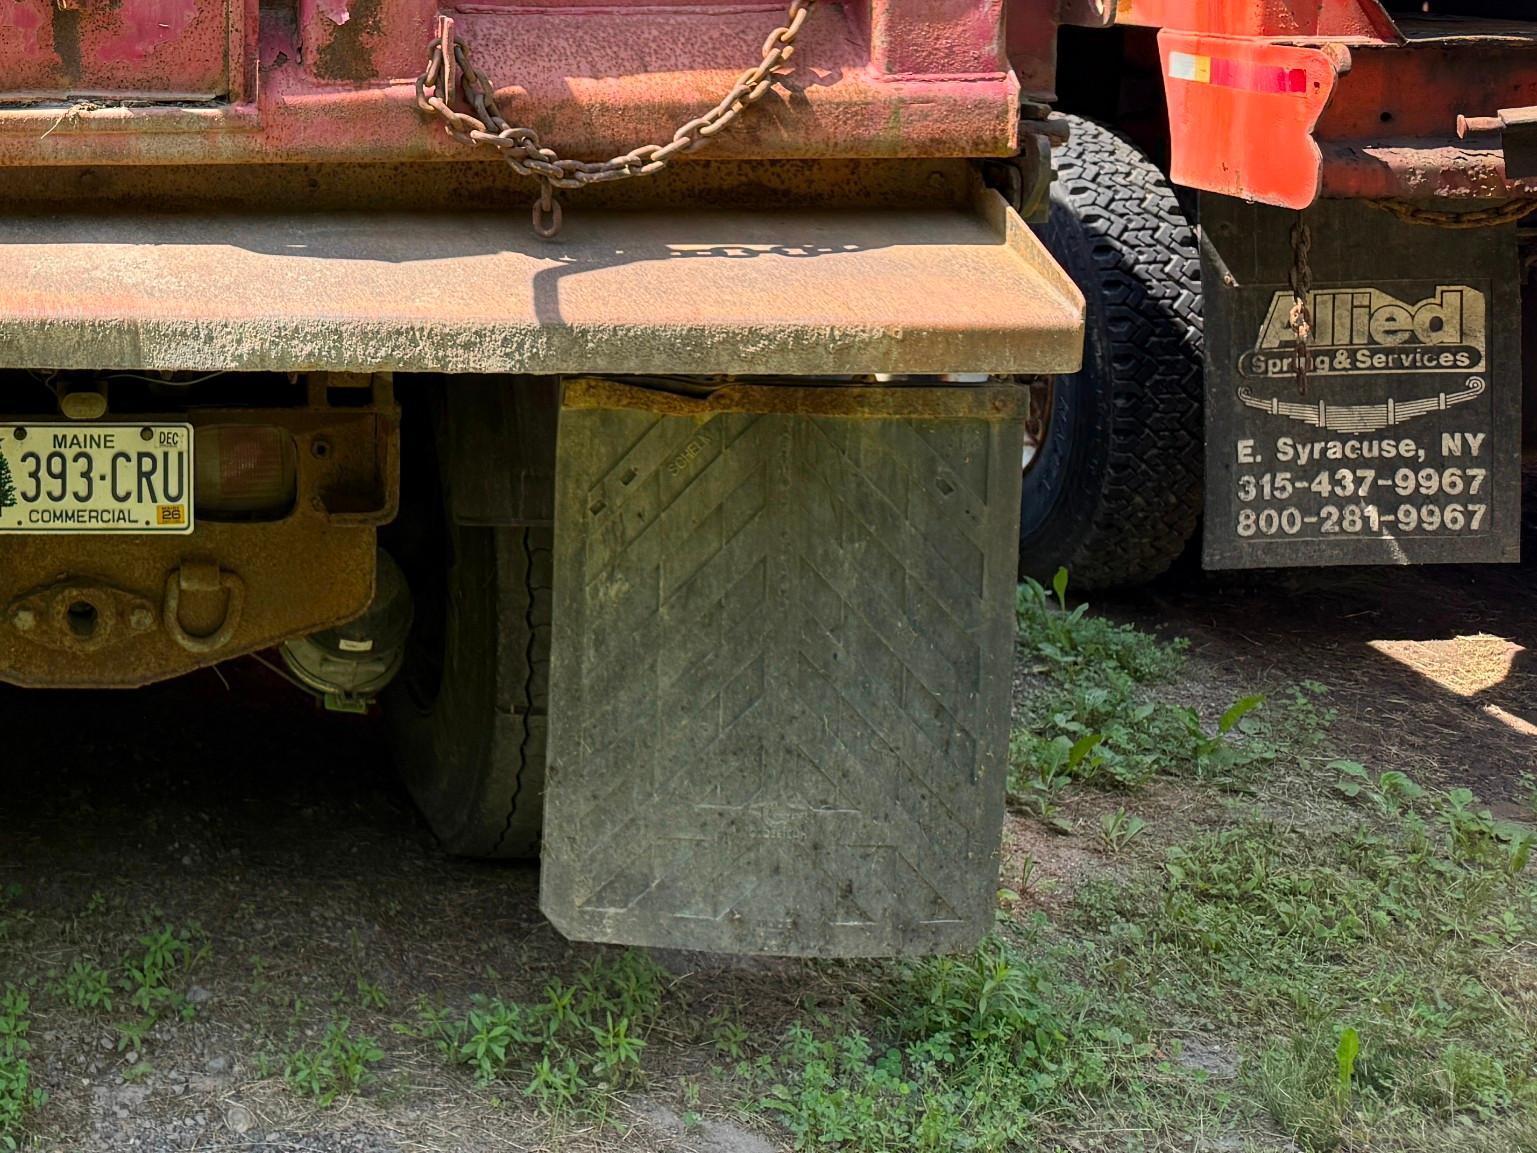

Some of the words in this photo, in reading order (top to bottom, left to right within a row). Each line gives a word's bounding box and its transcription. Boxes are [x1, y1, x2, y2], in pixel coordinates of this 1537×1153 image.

[1260, 288, 1464, 346] Allied
[52, 434, 115, 449] MAINE
[159, 431, 179, 445] DEC
[1237, 439, 1262, 464] E.
[1276, 437, 1426, 466] Syracuse,
[1441, 432, 1486, 457] NY
[1237, 467, 1487, 502] 315-437-9967
[28, 508, 139, 524] COMMERCIAL
[162, 510, 182, 519] 26
[1237, 503, 1488, 537] 800-281-9967
